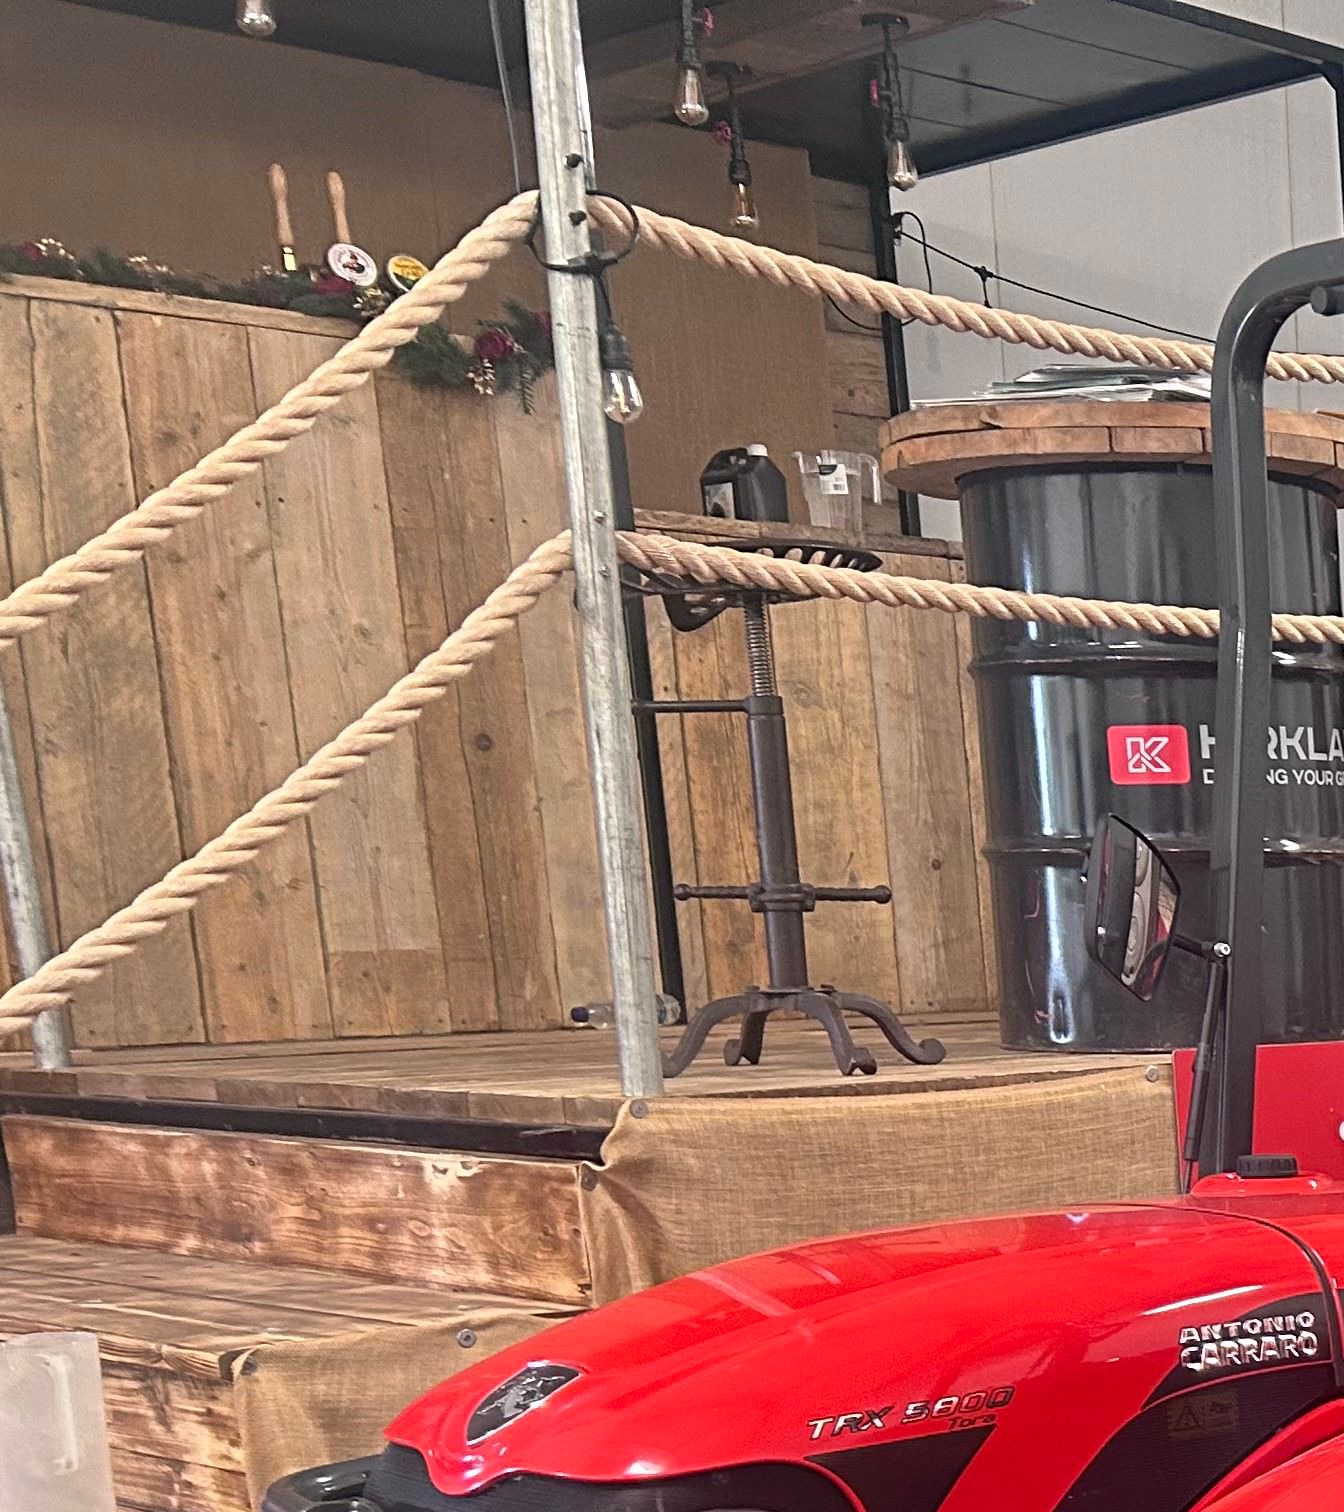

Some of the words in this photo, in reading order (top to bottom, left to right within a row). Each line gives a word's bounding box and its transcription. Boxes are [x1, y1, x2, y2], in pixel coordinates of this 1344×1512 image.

[1291, 769, 1333, 786] YOUR
[1179, 1311, 1316, 1344] ANTONIO
[1180, 1330, 1318, 1372] CARRARO
[807, 1406, 894, 1440] TRX
[902, 1386, 1014, 1424] 5800
